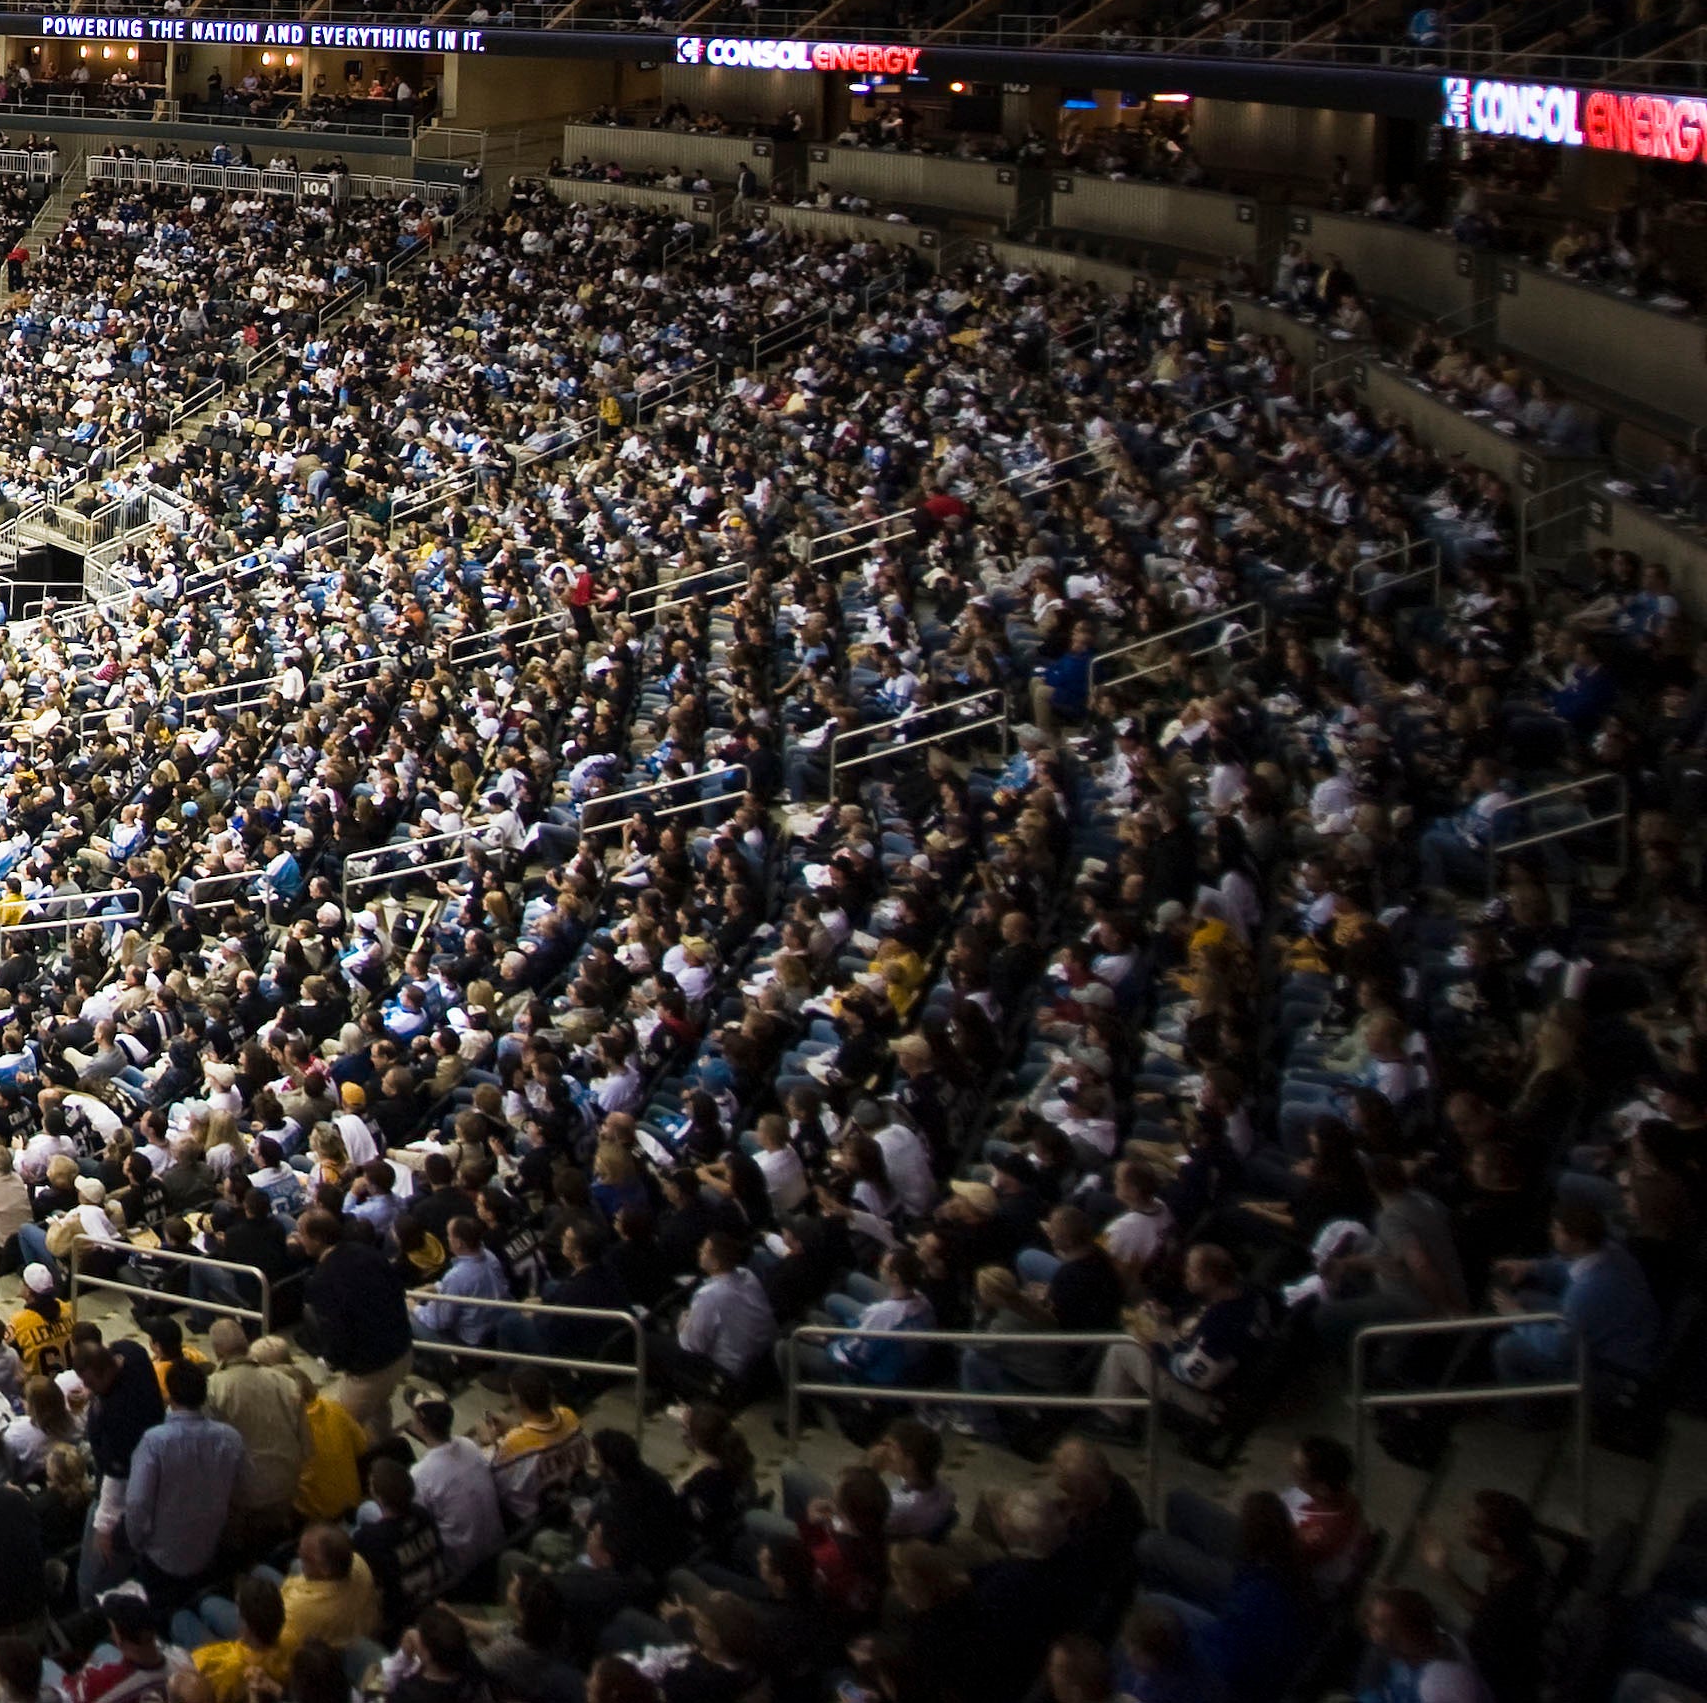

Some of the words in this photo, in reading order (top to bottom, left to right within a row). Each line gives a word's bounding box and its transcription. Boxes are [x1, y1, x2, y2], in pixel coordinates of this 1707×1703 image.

[43, 17, 142, 37] POWERING
[149, 20, 184, 38] THE
[192, 21, 257, 42] NATION
[264, 24, 303, 44] AND
[311, 25, 431, 48] EVERYTHING
[438, 29, 455, 50] IN
[463, 31, 486, 52] IT.
[707, 39, 812, 70] CONSOL
[1472, 81, 1583, 146] CONSOL
[303, 181, 330, 195] 104
